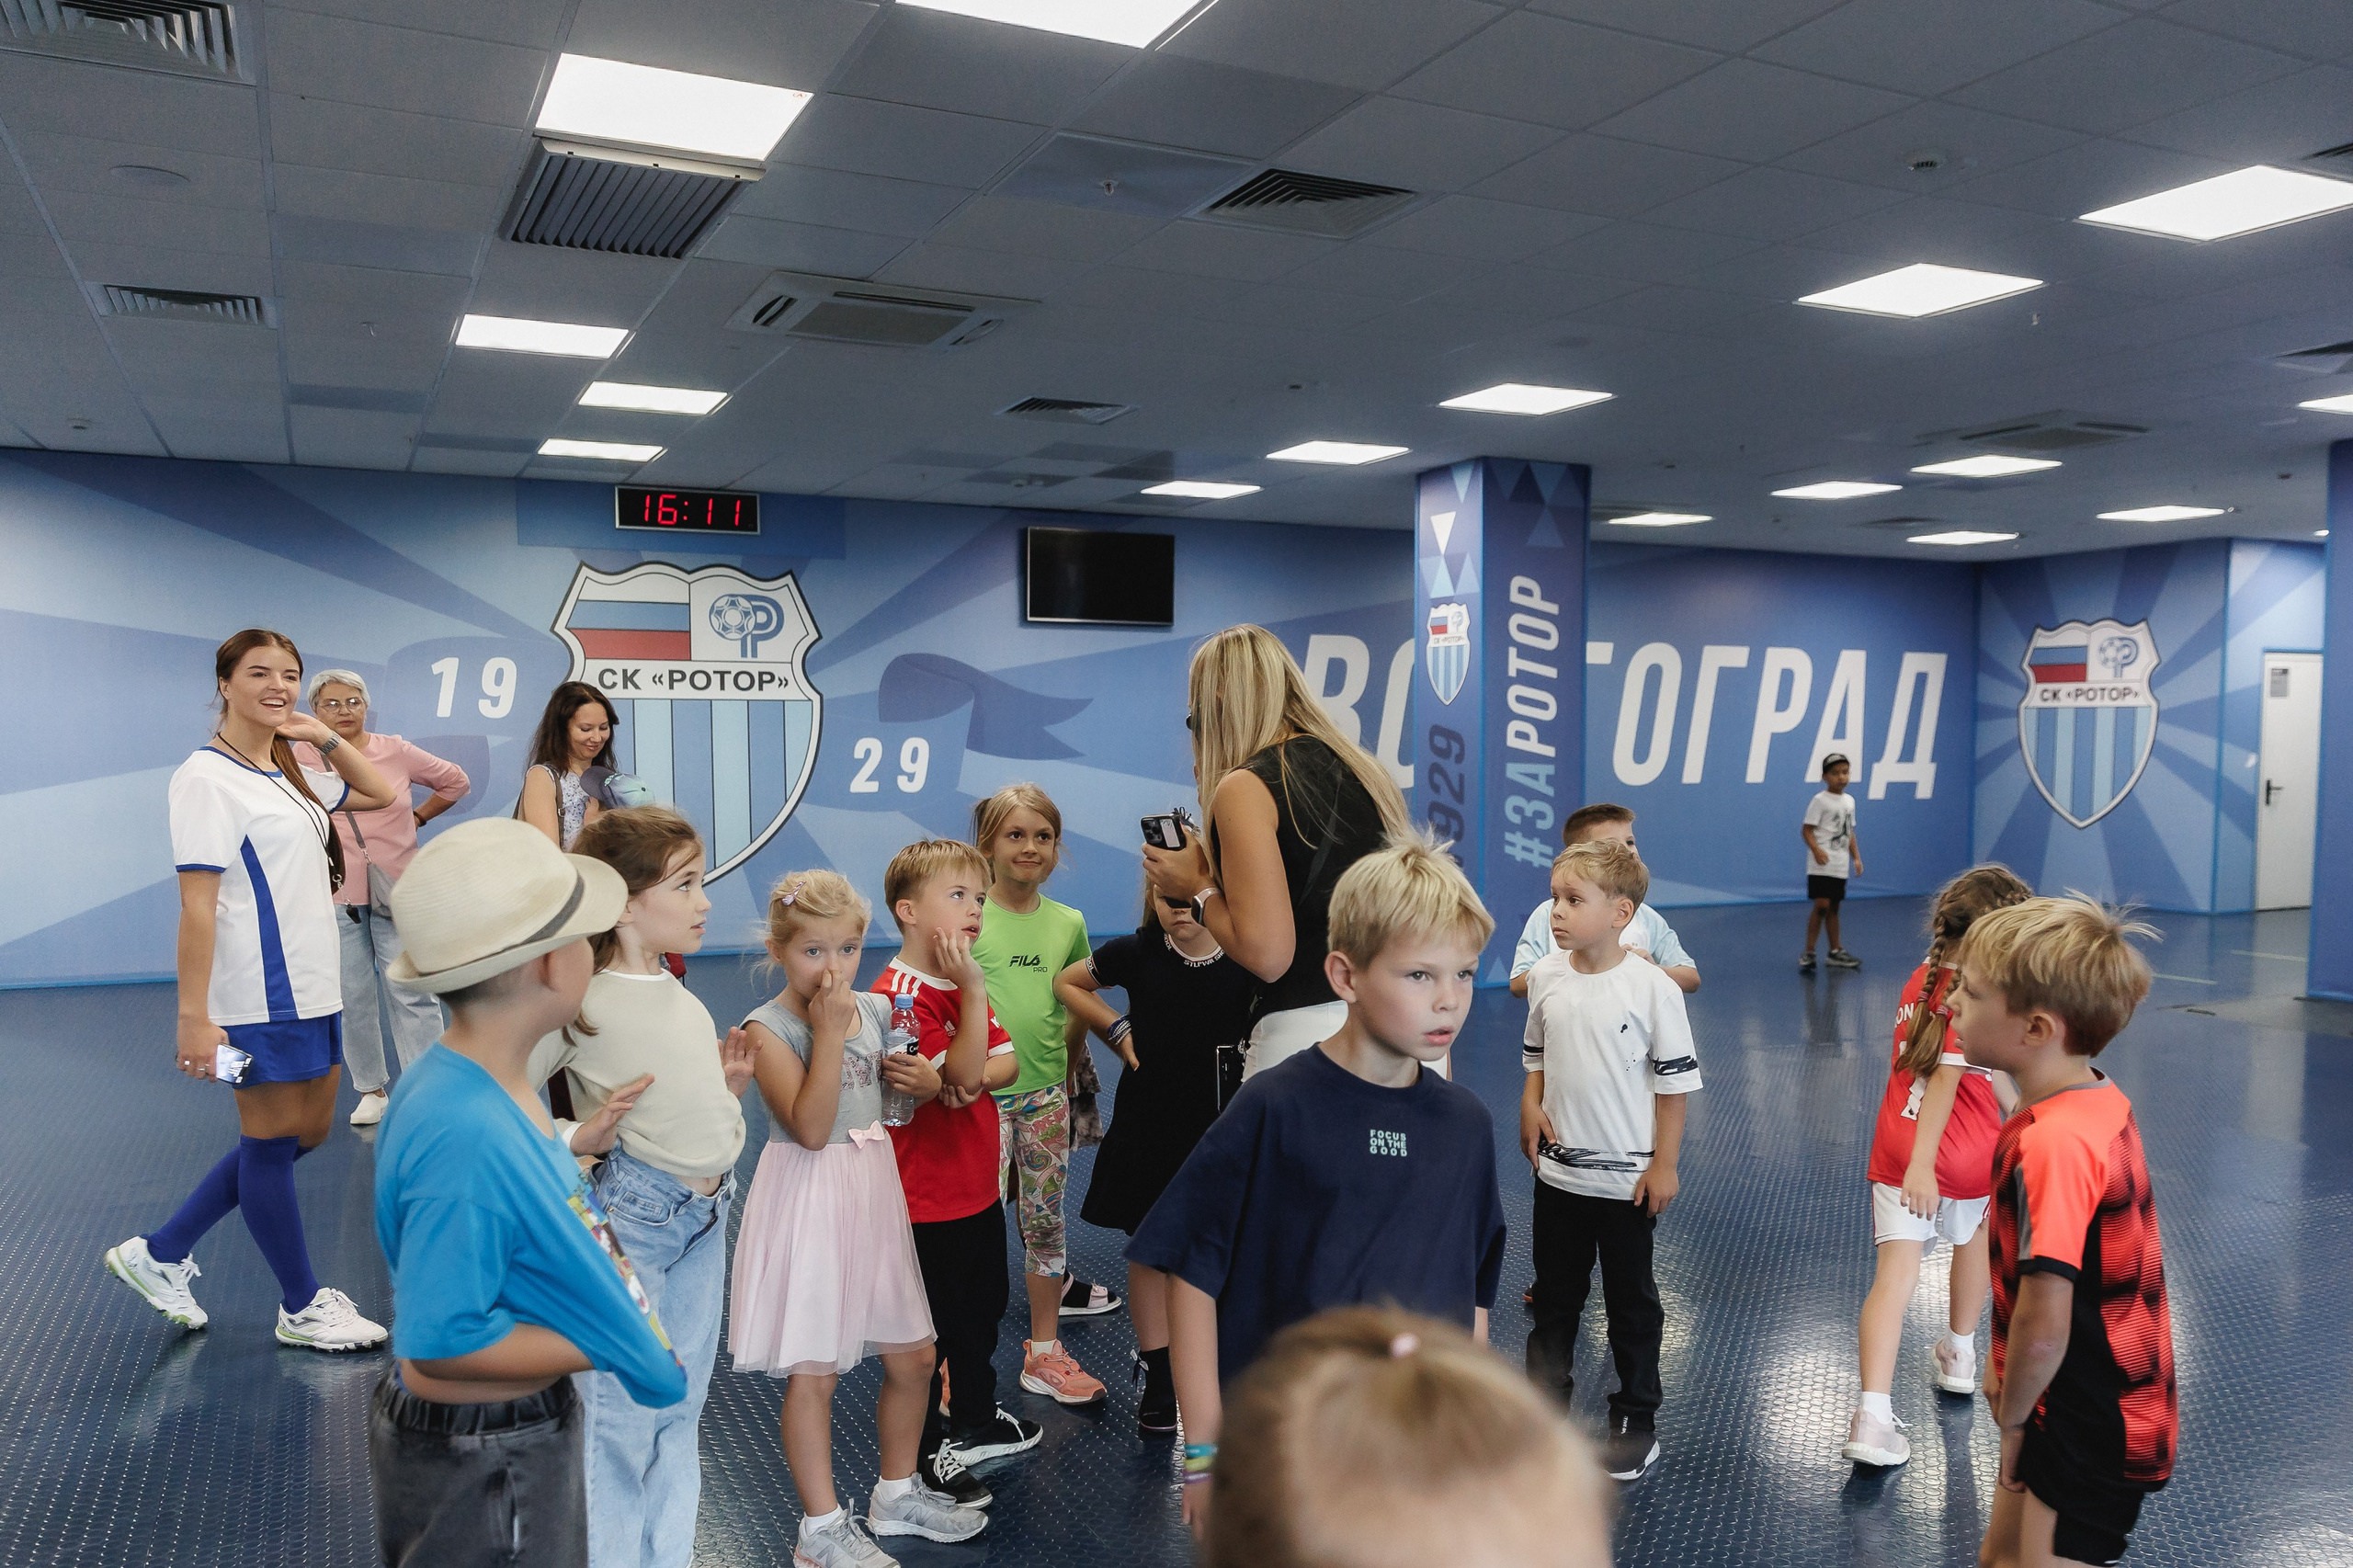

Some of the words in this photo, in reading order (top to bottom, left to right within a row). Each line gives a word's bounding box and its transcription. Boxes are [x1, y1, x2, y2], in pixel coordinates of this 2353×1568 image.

[644, 494, 741, 527] 16:11
[598, 668, 642, 690] СК
[652, 669, 789, 691] «РОТОР»
[2040, 687, 2061, 702] СК
[1303, 633, 1949, 801] ВОГРАД
[1428, 724, 1466, 867] 929
[1009, 954, 1040, 967] FILA
[1370, 1129, 1406, 1142] FOCUS
[1370, 1137, 1385, 1147] ON
[1387, 1139, 1406, 1150] THE
[1370, 1145, 1407, 1157] GOOD
